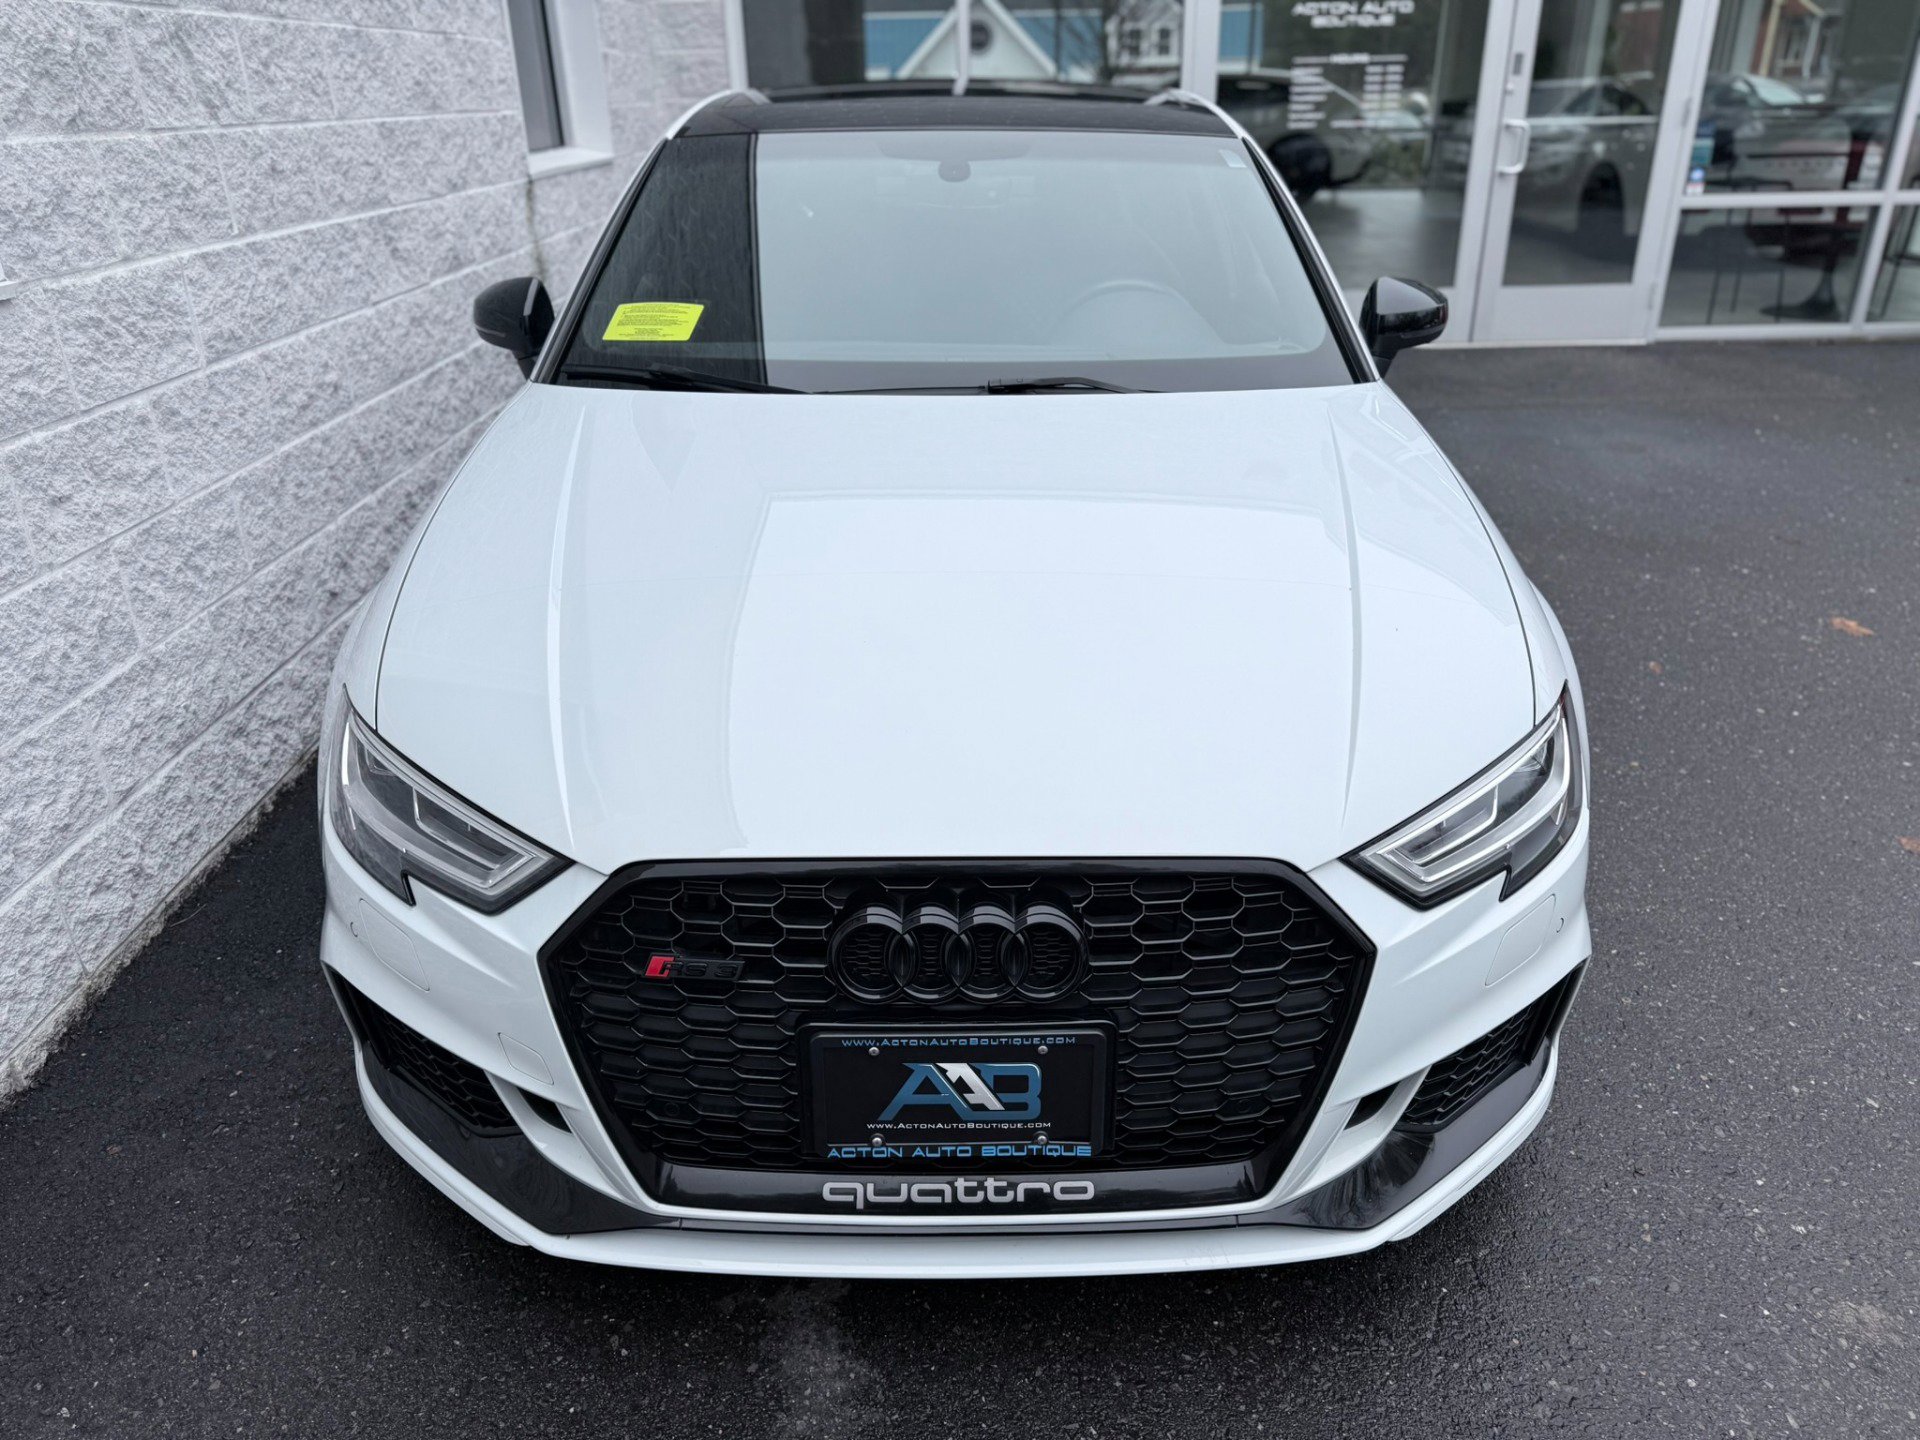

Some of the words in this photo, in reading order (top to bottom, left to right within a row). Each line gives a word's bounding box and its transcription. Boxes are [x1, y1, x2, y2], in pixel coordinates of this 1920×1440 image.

[827, 1146, 903, 1158] ACTON
[912, 1146, 972, 1157] AUTO
[981, 1145, 1092, 1157] BOUTIQUE
[822, 1177, 1095, 1210] quattro
